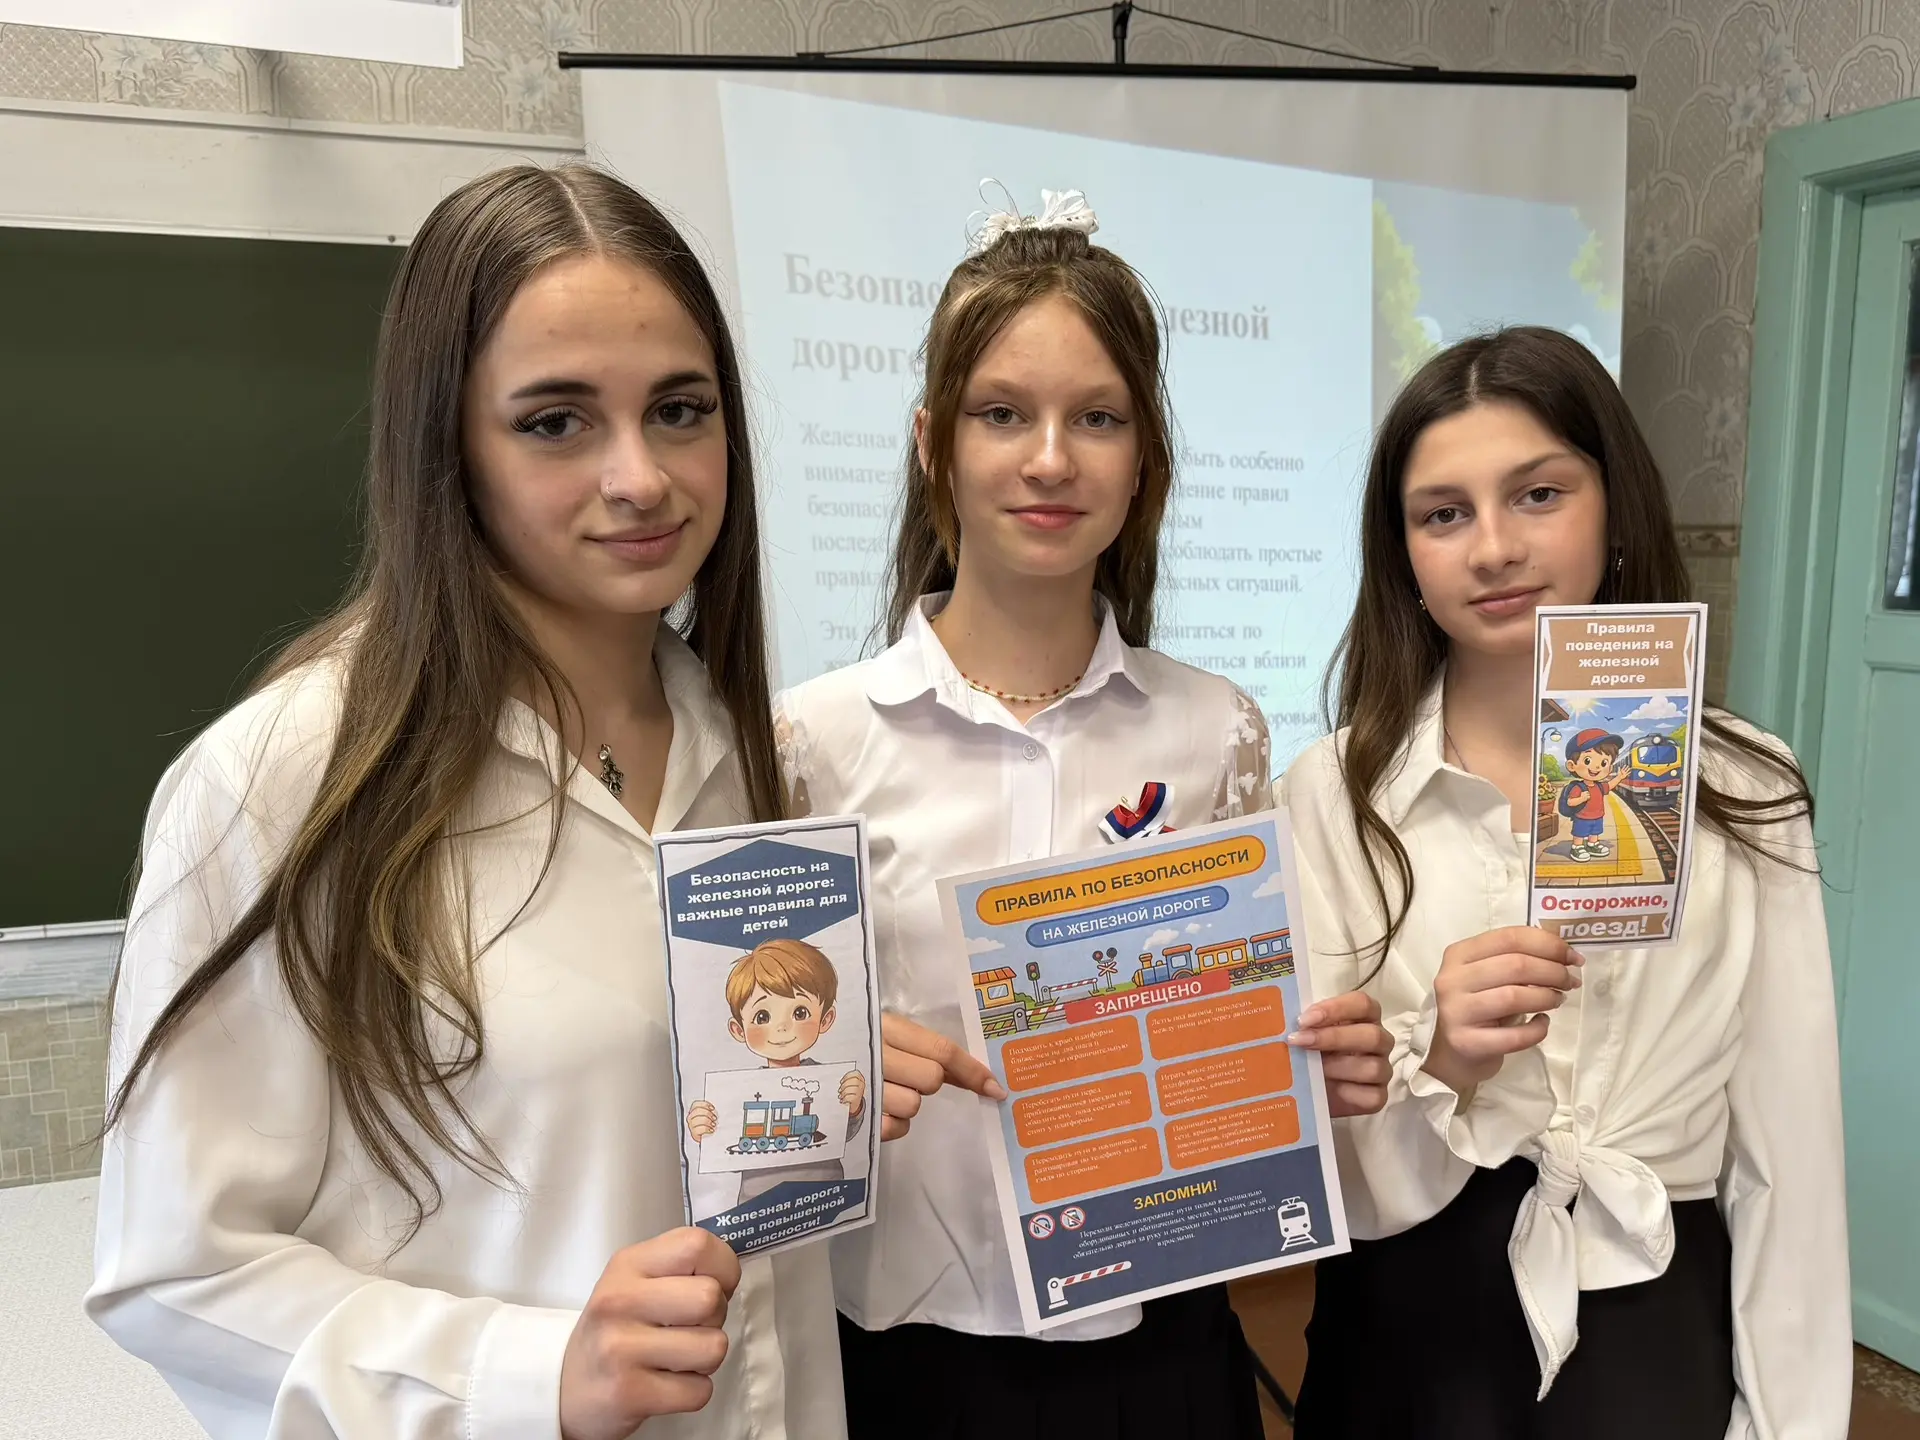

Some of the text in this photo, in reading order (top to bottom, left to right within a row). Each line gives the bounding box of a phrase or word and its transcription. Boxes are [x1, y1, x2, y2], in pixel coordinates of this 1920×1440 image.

[783, 253, 1270, 341] Безопас лезной
[1229, 450, 1304, 472] особенно
[1232, 485, 1290, 506] правил
[1258, 547, 1323, 567] простые
[820, 620, 856, 640] Эти
[1242, 625, 1262, 640] по
[1587, 623, 1655, 636] Правила
[1566, 640, 1673, 652] поведения на
[1253, 650, 1307, 669] вблизи
[1579, 655, 1659, 668] железной
[1591, 673, 1646, 685] дороге
[690, 862, 830, 886] Безопасность на
[995, 849, 1250, 913] ПРАВИЛА ПО БЕЗОПАСНОСТИ
[687, 878, 835, 904] железной дороге:
[677, 893, 847, 922] важные правила для
[1541, 895, 1668, 912] Осторожно,
[742, 917, 788, 934] детей
[1043, 895, 1211, 941] НА ЖЕЛЕЗНОЙ ДОРОГЕ
[1560, 916, 1648, 938] поезд!
[1095, 980, 1203, 1015] ЗАПРЕЩЕНО
[1133, 1179, 1219, 1211] ЗАПОМНИ!
[716, 1201, 791, 1227] Железная
[794, 1186, 840, 1208] дорога
[720, 1196, 845, 1243] зона повышенной
[745, 1217, 821, 1248] опасности!
